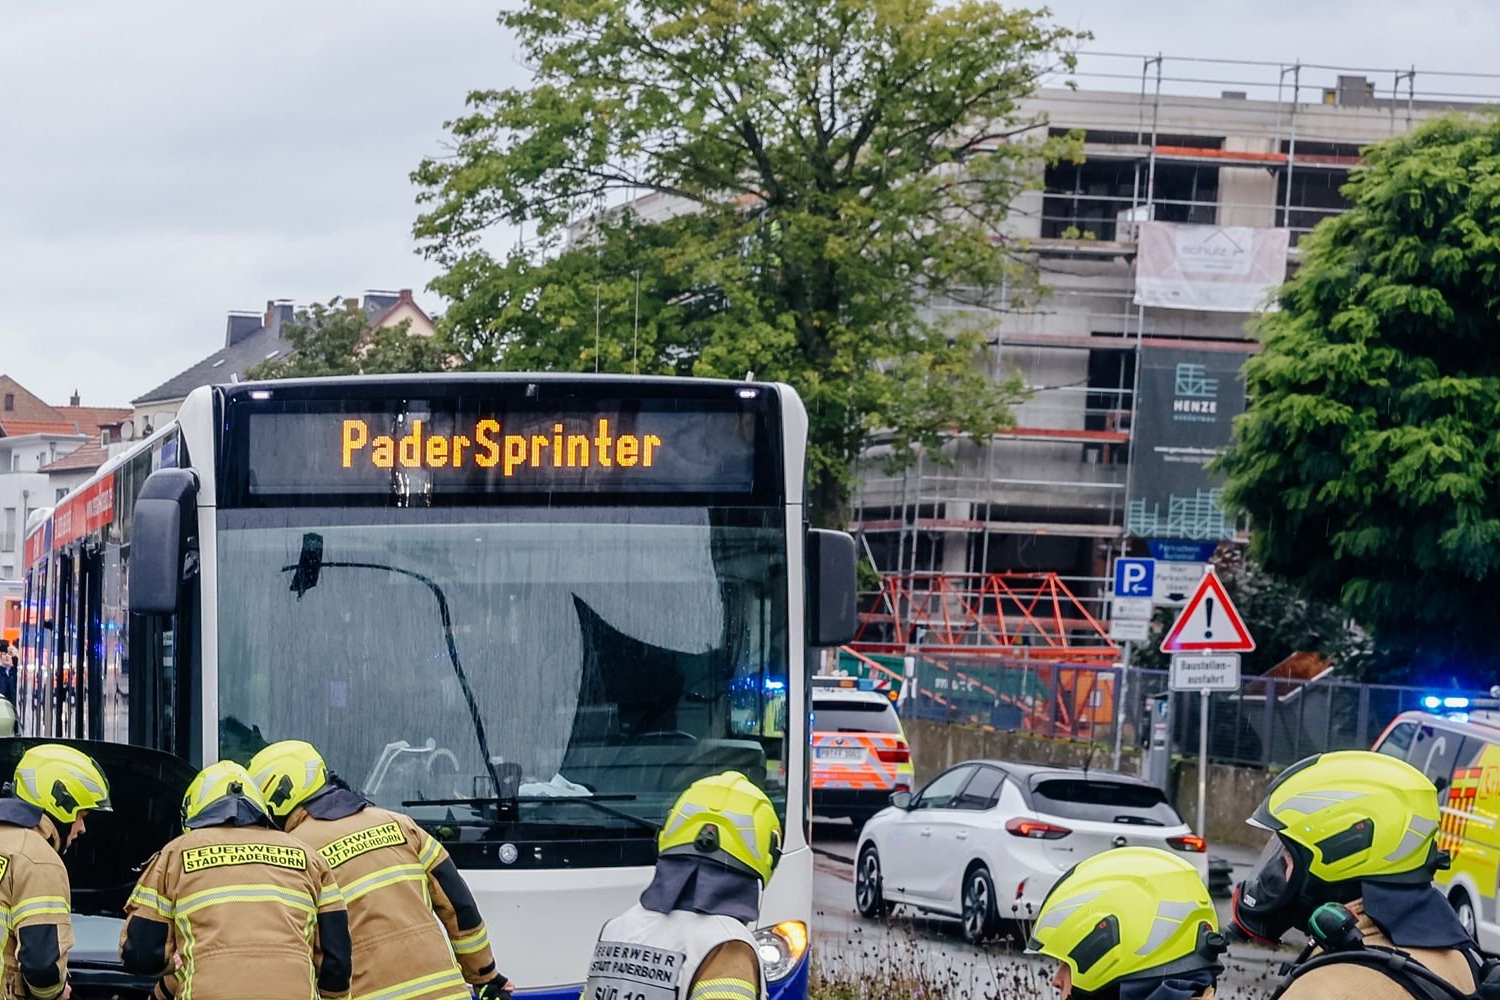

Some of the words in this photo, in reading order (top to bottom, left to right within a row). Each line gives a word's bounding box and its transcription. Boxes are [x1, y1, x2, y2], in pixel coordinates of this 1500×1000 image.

[1173, 400, 1217, 413] HENZE
[341, 419, 662, 477] PaderSprinter
[1123, 563, 1147, 593] P
[186, 846, 301, 858] FEUERWEHR
[322, 825, 397, 858] UERWEHR
[343, 834, 401, 859] PADERBORN
[186, 855, 226, 870] STADT
[230, 854, 305, 867] PADERBORN
[596, 945, 675, 968] FEUERWEHR
[591, 960, 610, 972] STADT
[612, 961, 673, 983] PADERBORN
